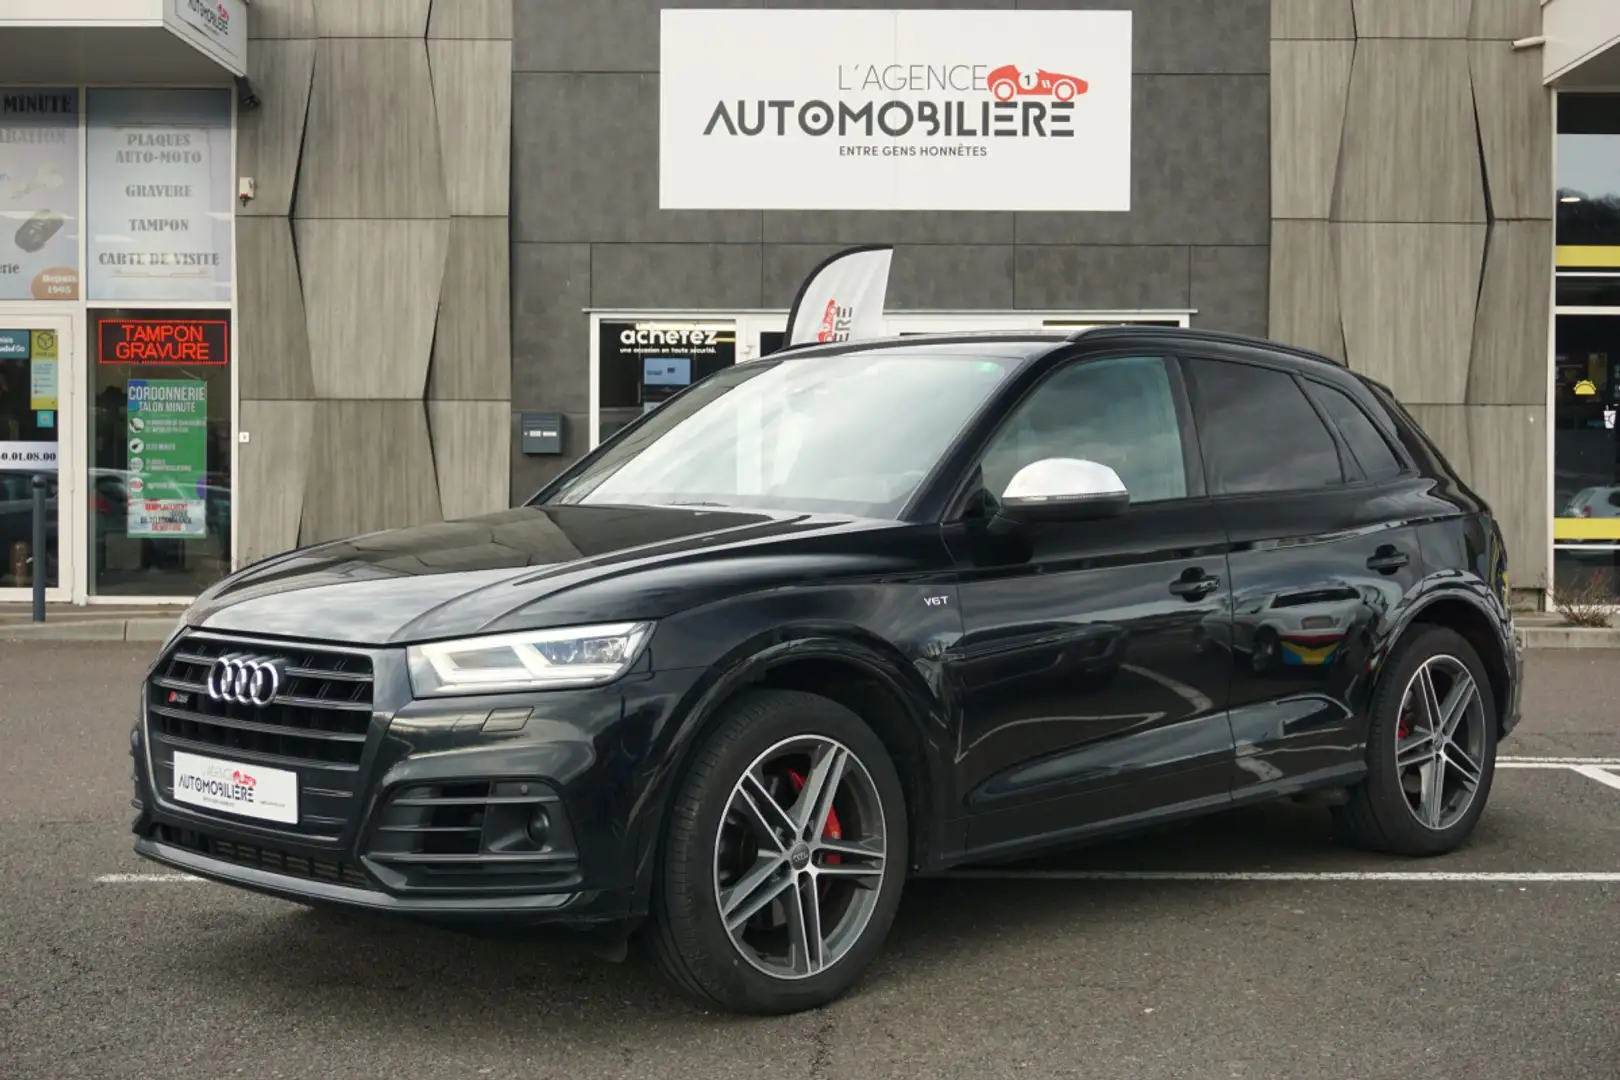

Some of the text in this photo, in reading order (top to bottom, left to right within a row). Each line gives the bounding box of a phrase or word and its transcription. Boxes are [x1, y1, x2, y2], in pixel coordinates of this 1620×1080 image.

[4, 95, 72, 114] MINUTE
[127, 133, 191, 147] PLAQUES
[116, 151, 202, 163] AUTO-MOTO
[839, 143, 988, 157] ENTRE GENS HONNÊTES
[125, 185, 193, 197] GRAVURE
[129, 219, 189, 231] TAMPON
[99, 252, 220, 266] CARTE DE VISITE
[121, 325, 203, 342] TAMPON
[620, 322, 718, 345] achetez
[115, 342, 209, 359] GRAVURE
[128, 386, 205, 400] CORDONNERIE
[138, 401, 196, 412] TALON MINUTE
[923, 595, 949, 606] V6T
